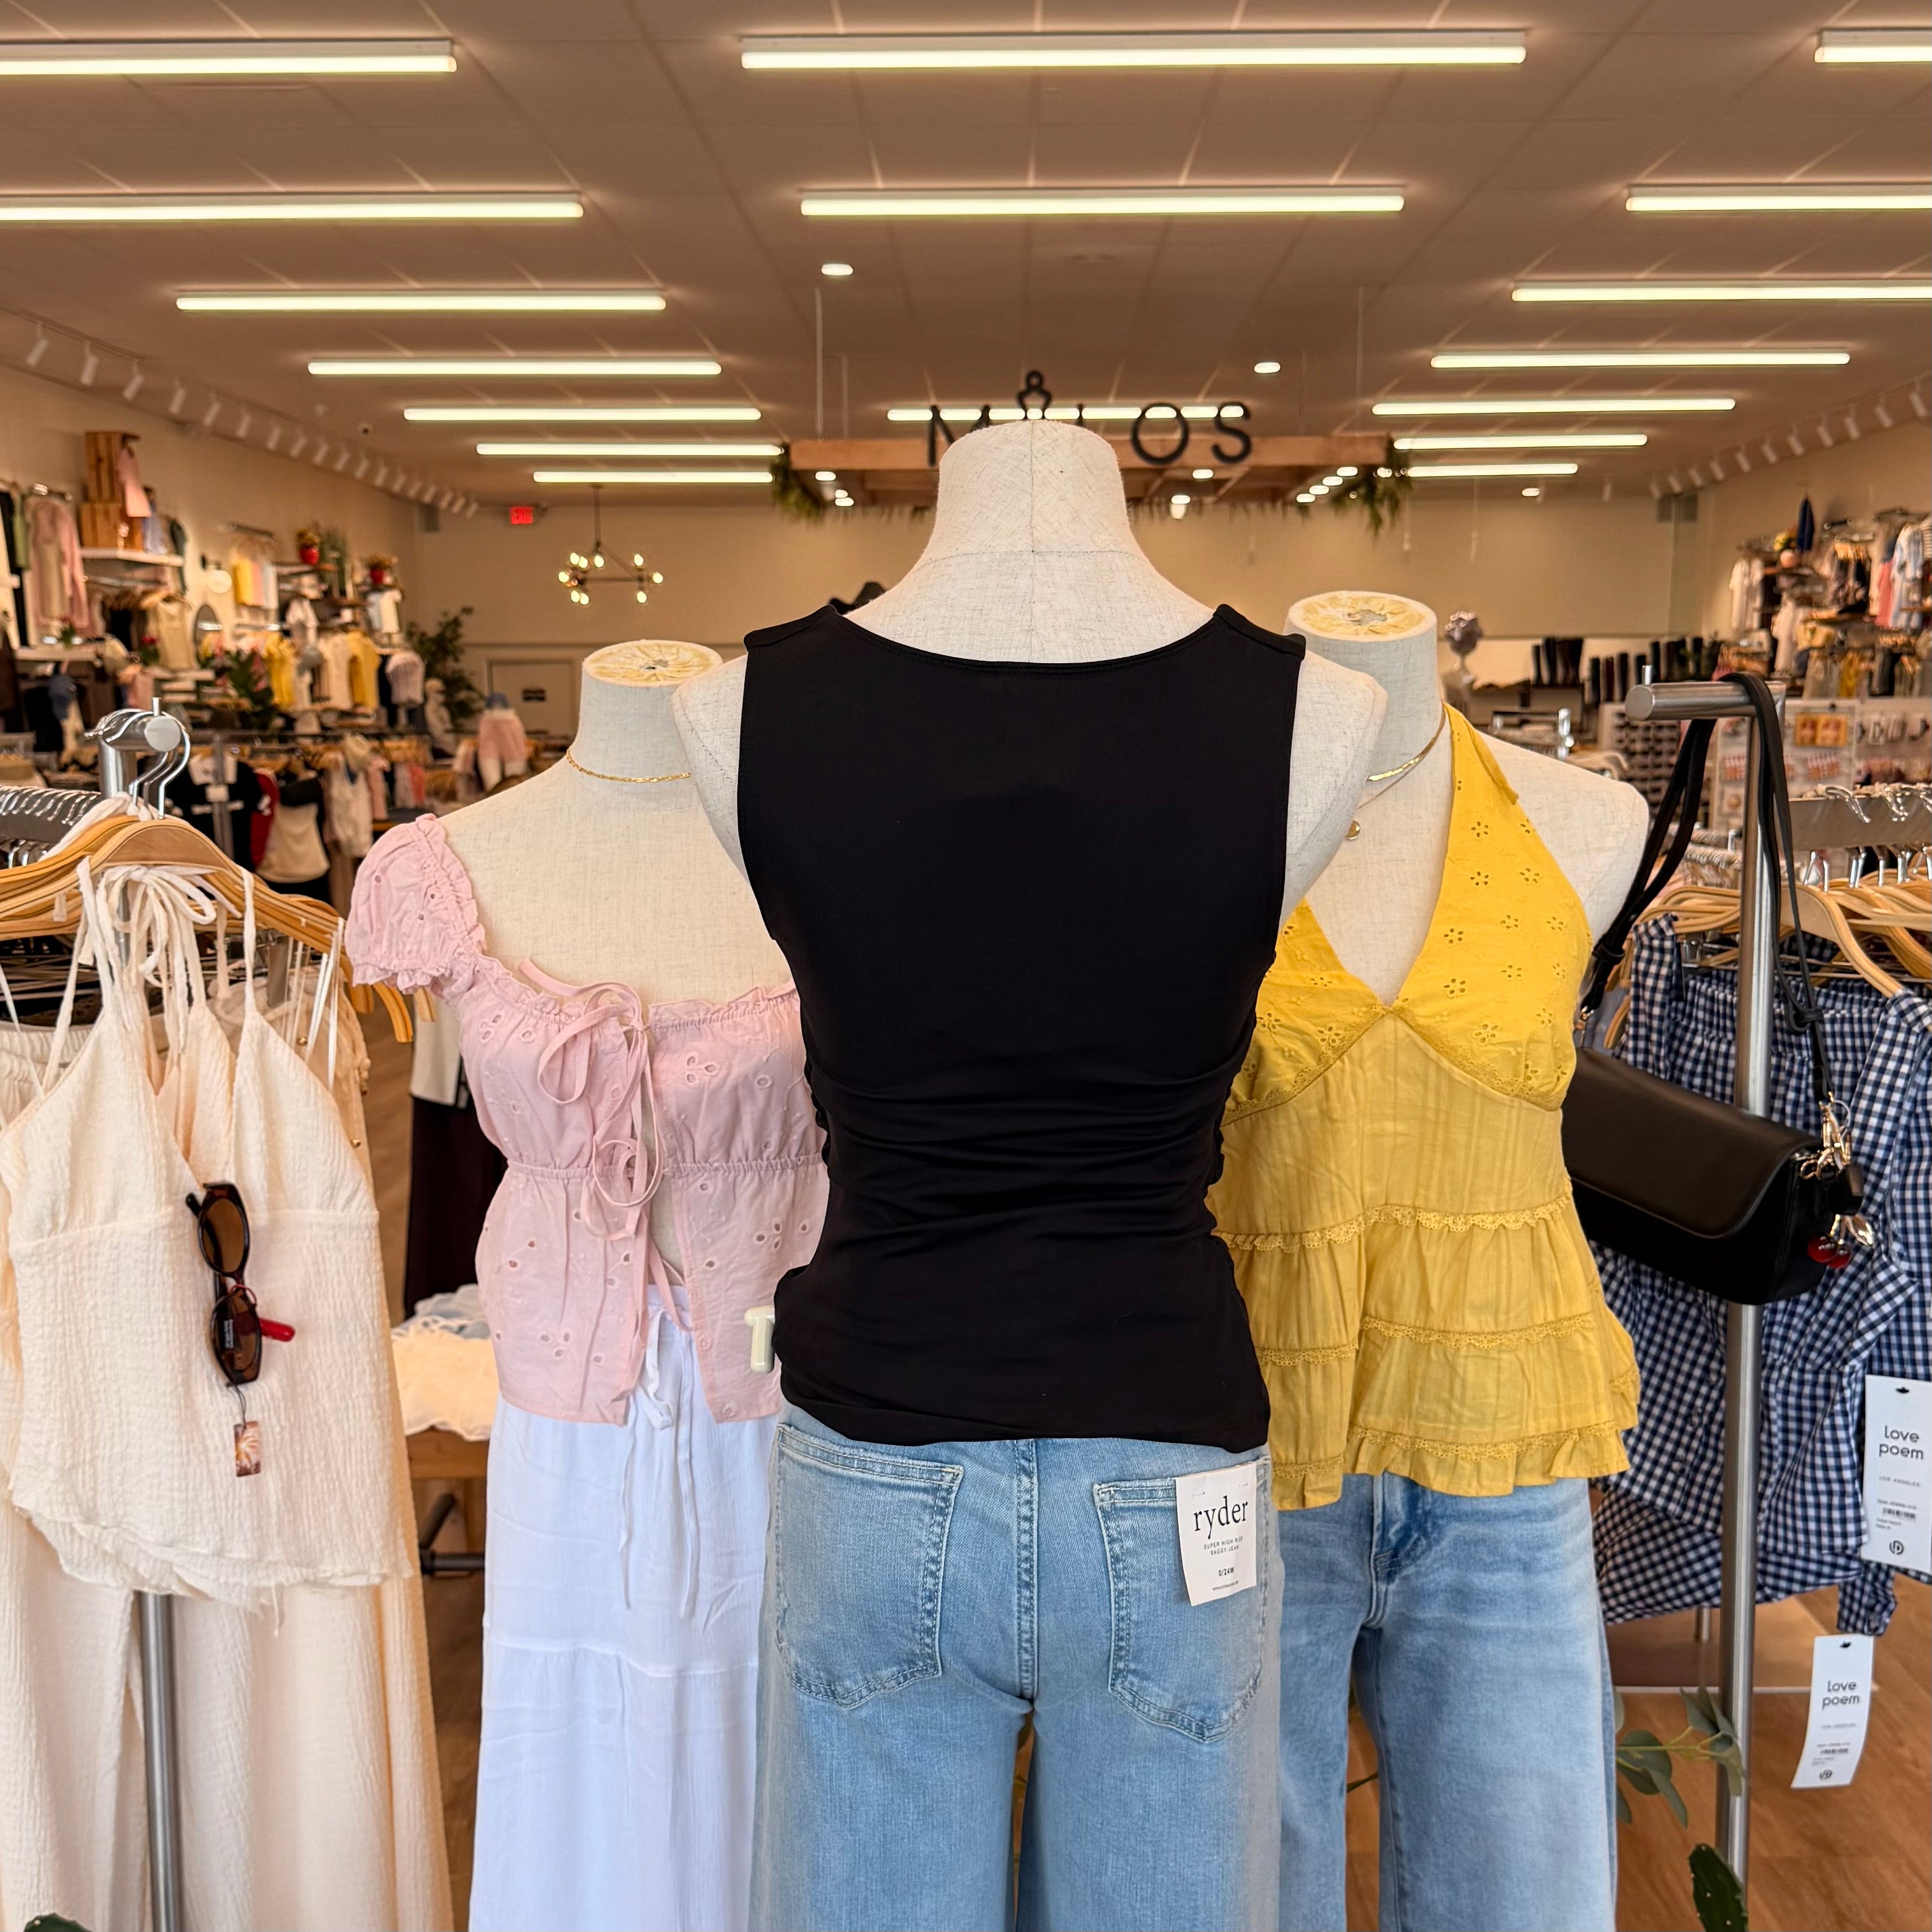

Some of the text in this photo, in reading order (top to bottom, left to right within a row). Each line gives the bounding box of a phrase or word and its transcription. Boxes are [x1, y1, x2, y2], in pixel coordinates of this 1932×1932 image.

[1879, 1443, 1923, 1460] poem
[1194, 1495, 1248, 1540] ryder
[1822, 1695, 1860, 1710] poem
